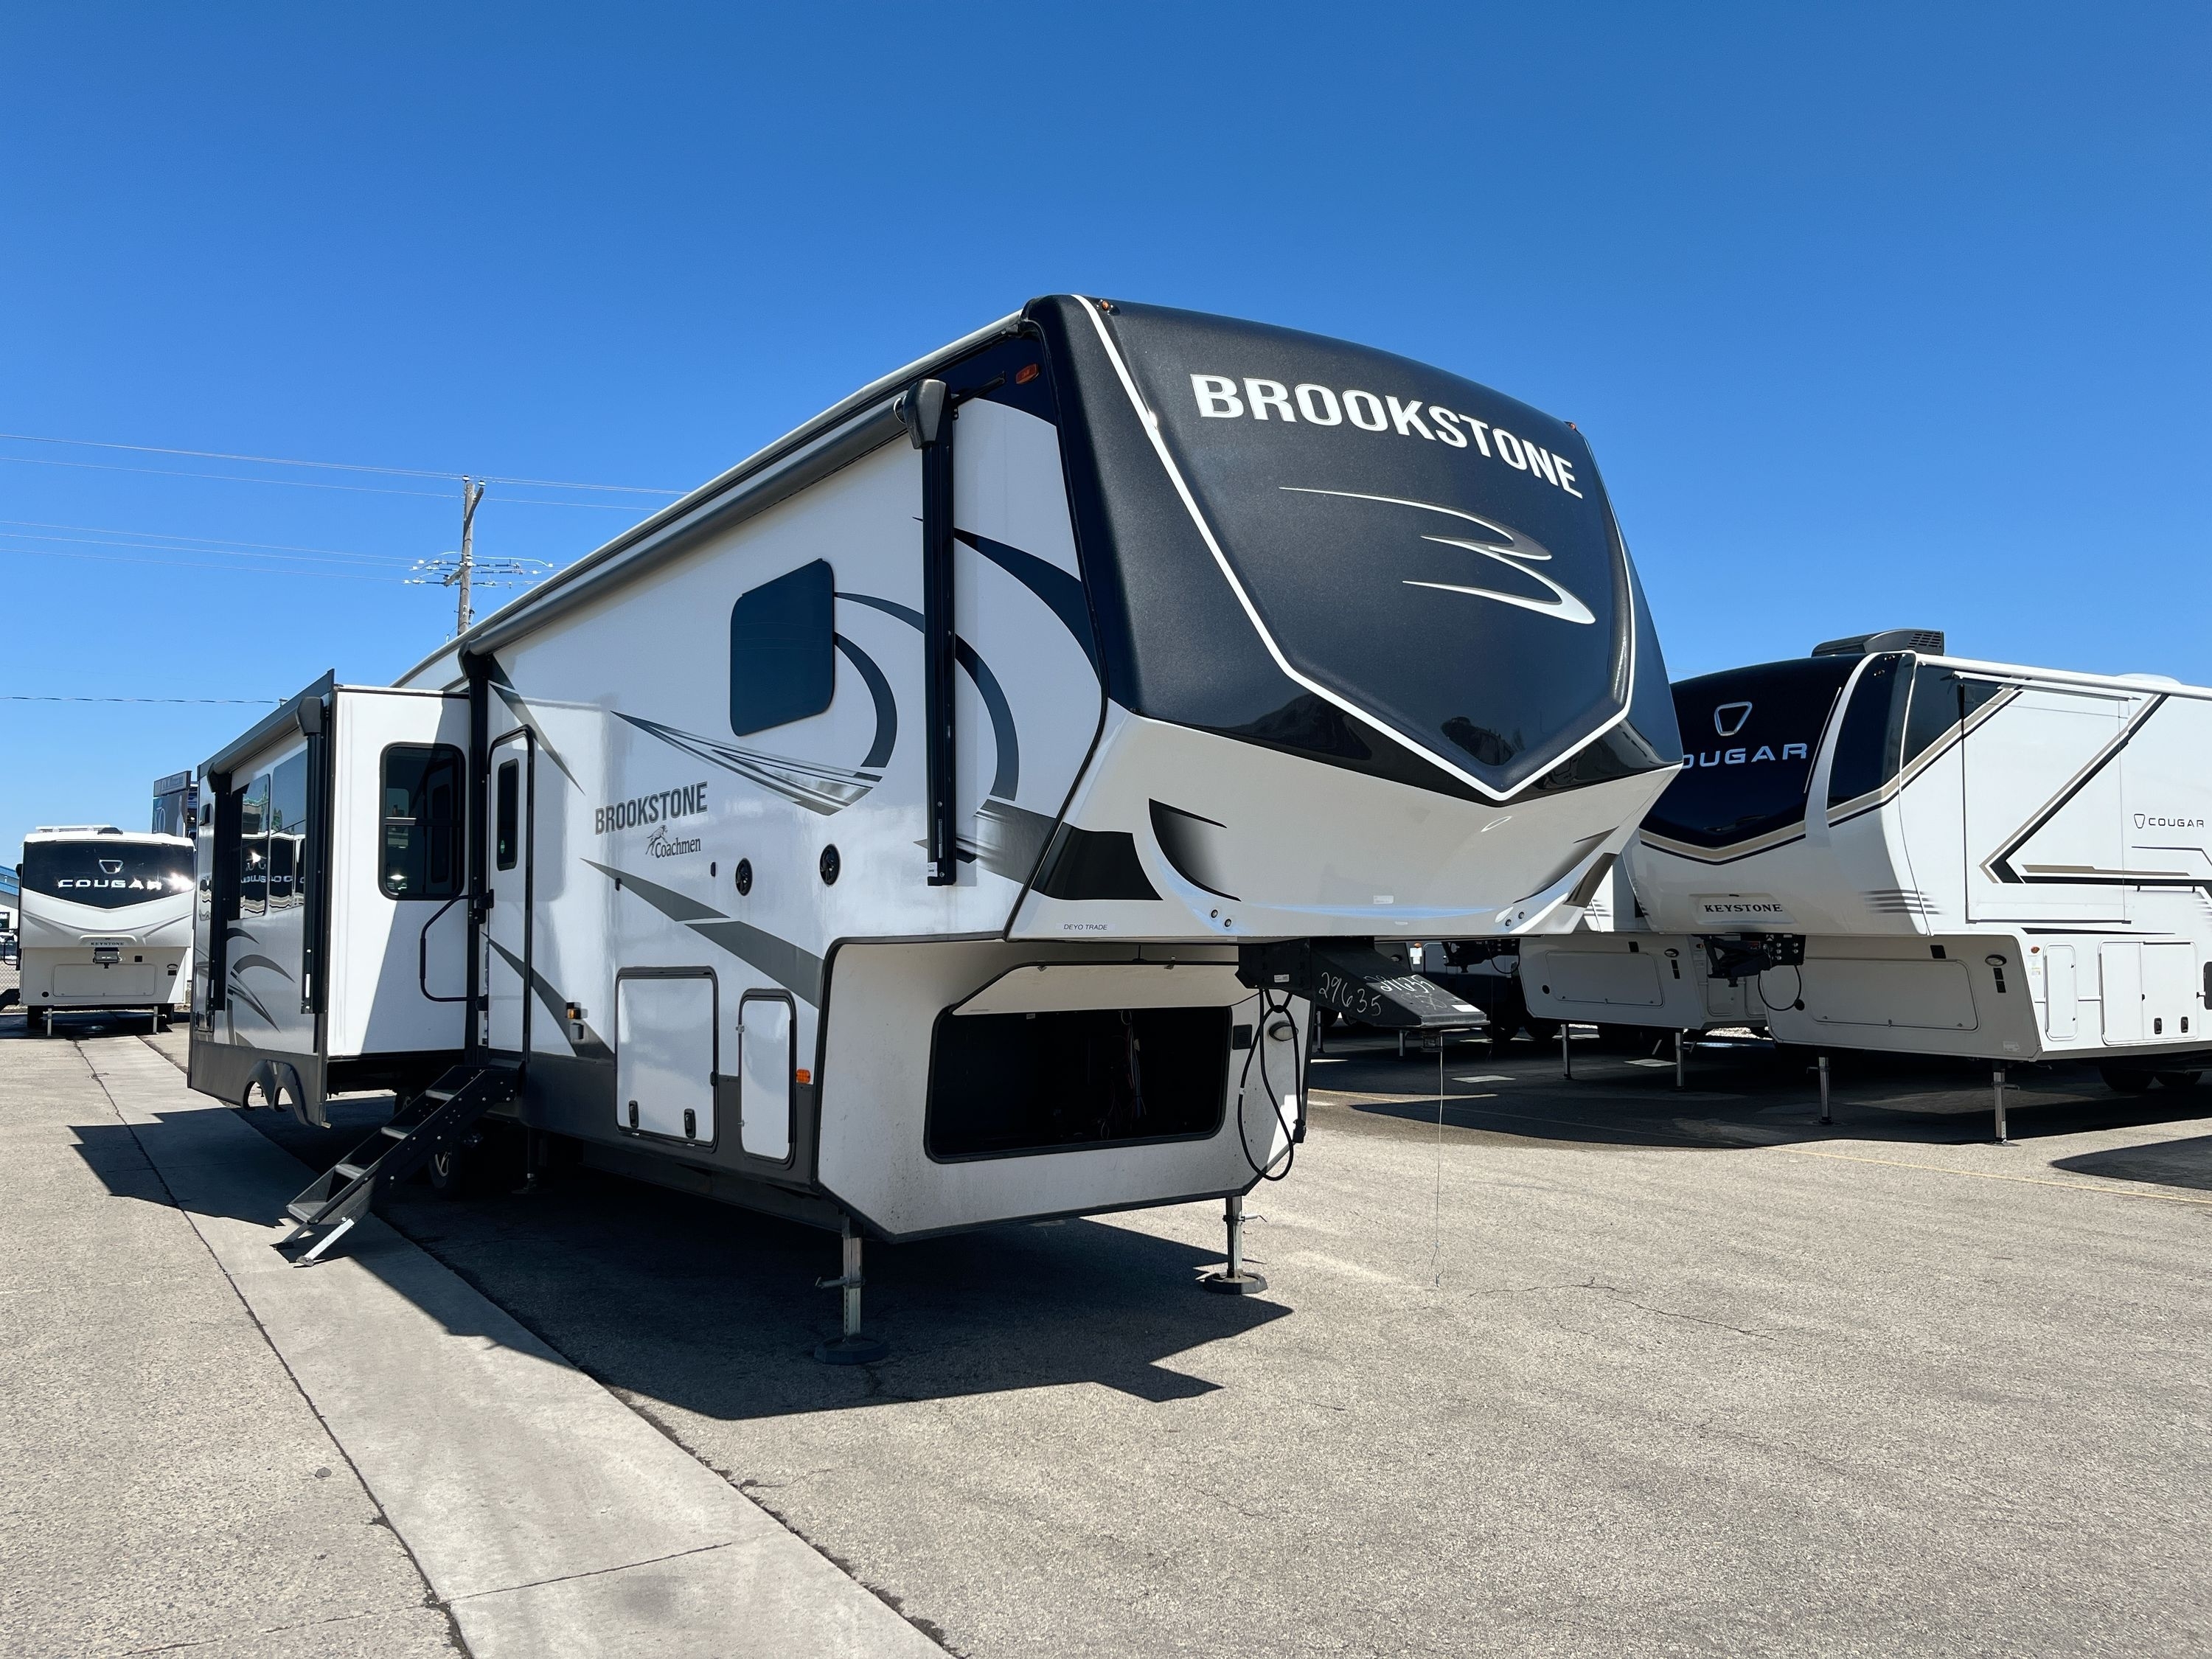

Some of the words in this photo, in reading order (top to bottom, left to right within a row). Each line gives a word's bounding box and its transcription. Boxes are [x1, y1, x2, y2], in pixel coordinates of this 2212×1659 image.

[1189, 373, 1584, 499] BROOKSTONE
[1682, 742, 1808, 770] OUGAR
[594, 781, 708, 835] BROOKSTONE
[2148, 817, 2205, 828] COUGAR
[655, 836, 701, 859] Coachmen
[58, 878, 162, 891] COUGAR
[1703, 903, 1783, 913] KEYSTONE
[1318, 972, 1382, 1017] 29635
